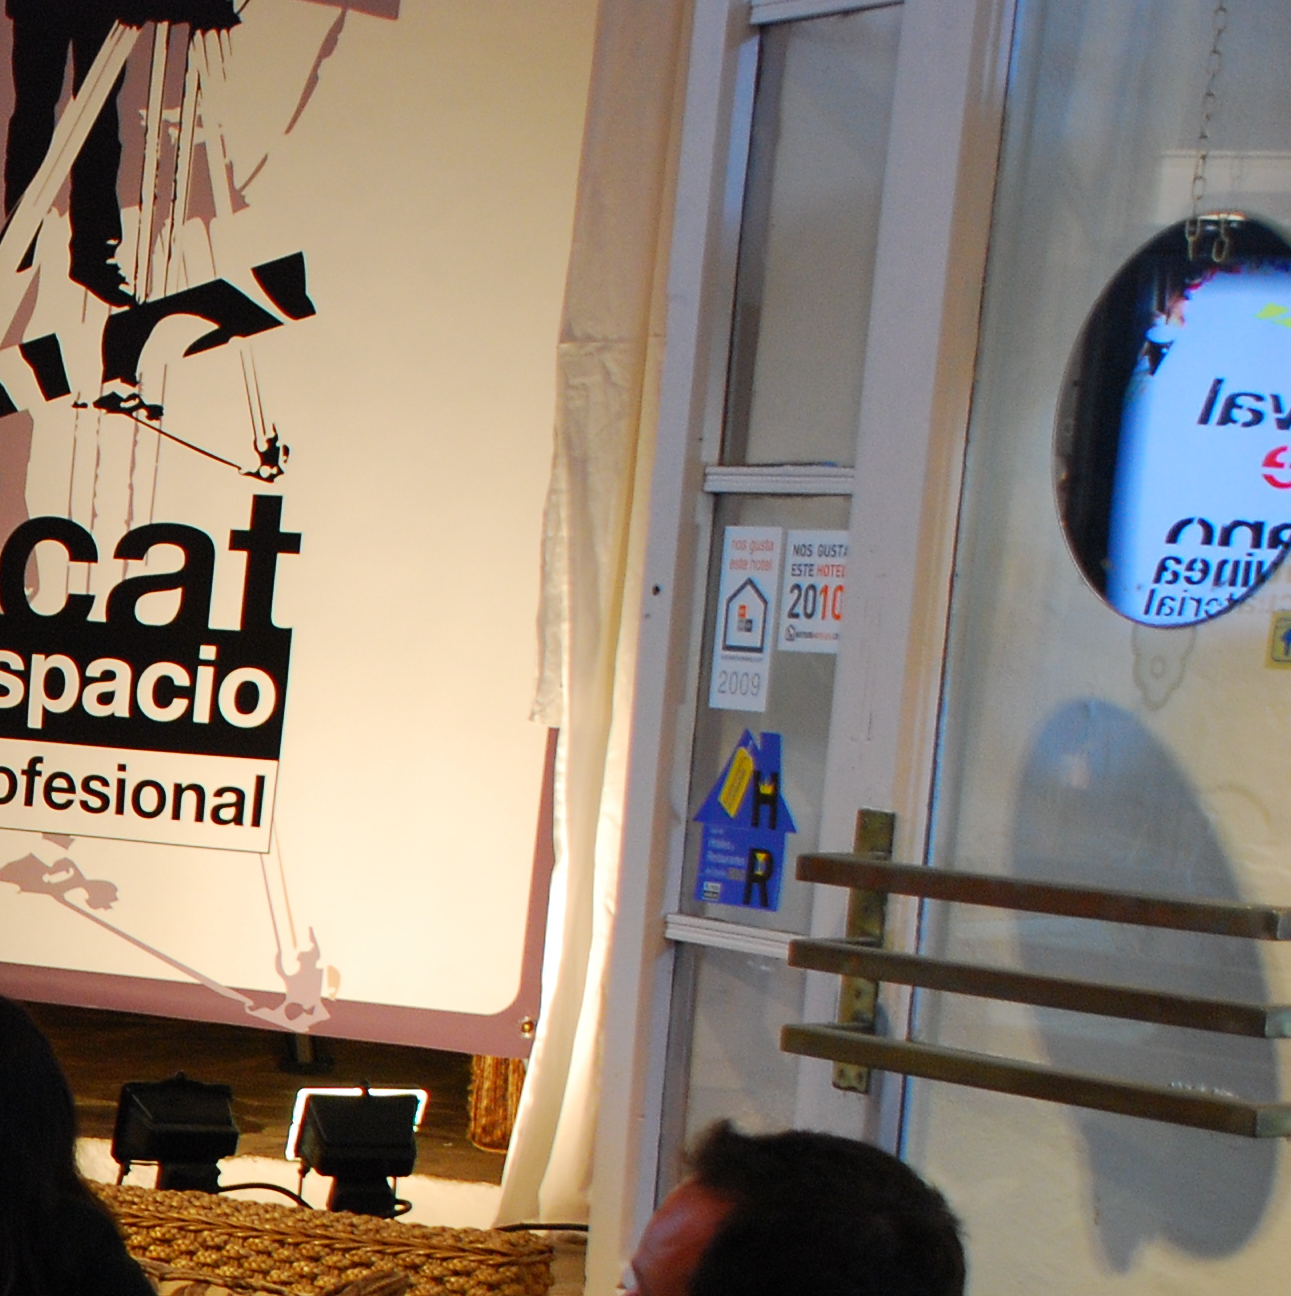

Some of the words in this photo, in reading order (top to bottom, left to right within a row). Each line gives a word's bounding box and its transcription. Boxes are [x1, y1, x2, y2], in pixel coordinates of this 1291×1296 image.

[749, 539, 774, 555] gusta
[792, 543, 813, 557] NOS
[729, 558, 748, 570] este
[750, 558, 772, 571] hotel
[791, 563, 815, 577] ESTE
[717, 670, 761, 696] 2009
